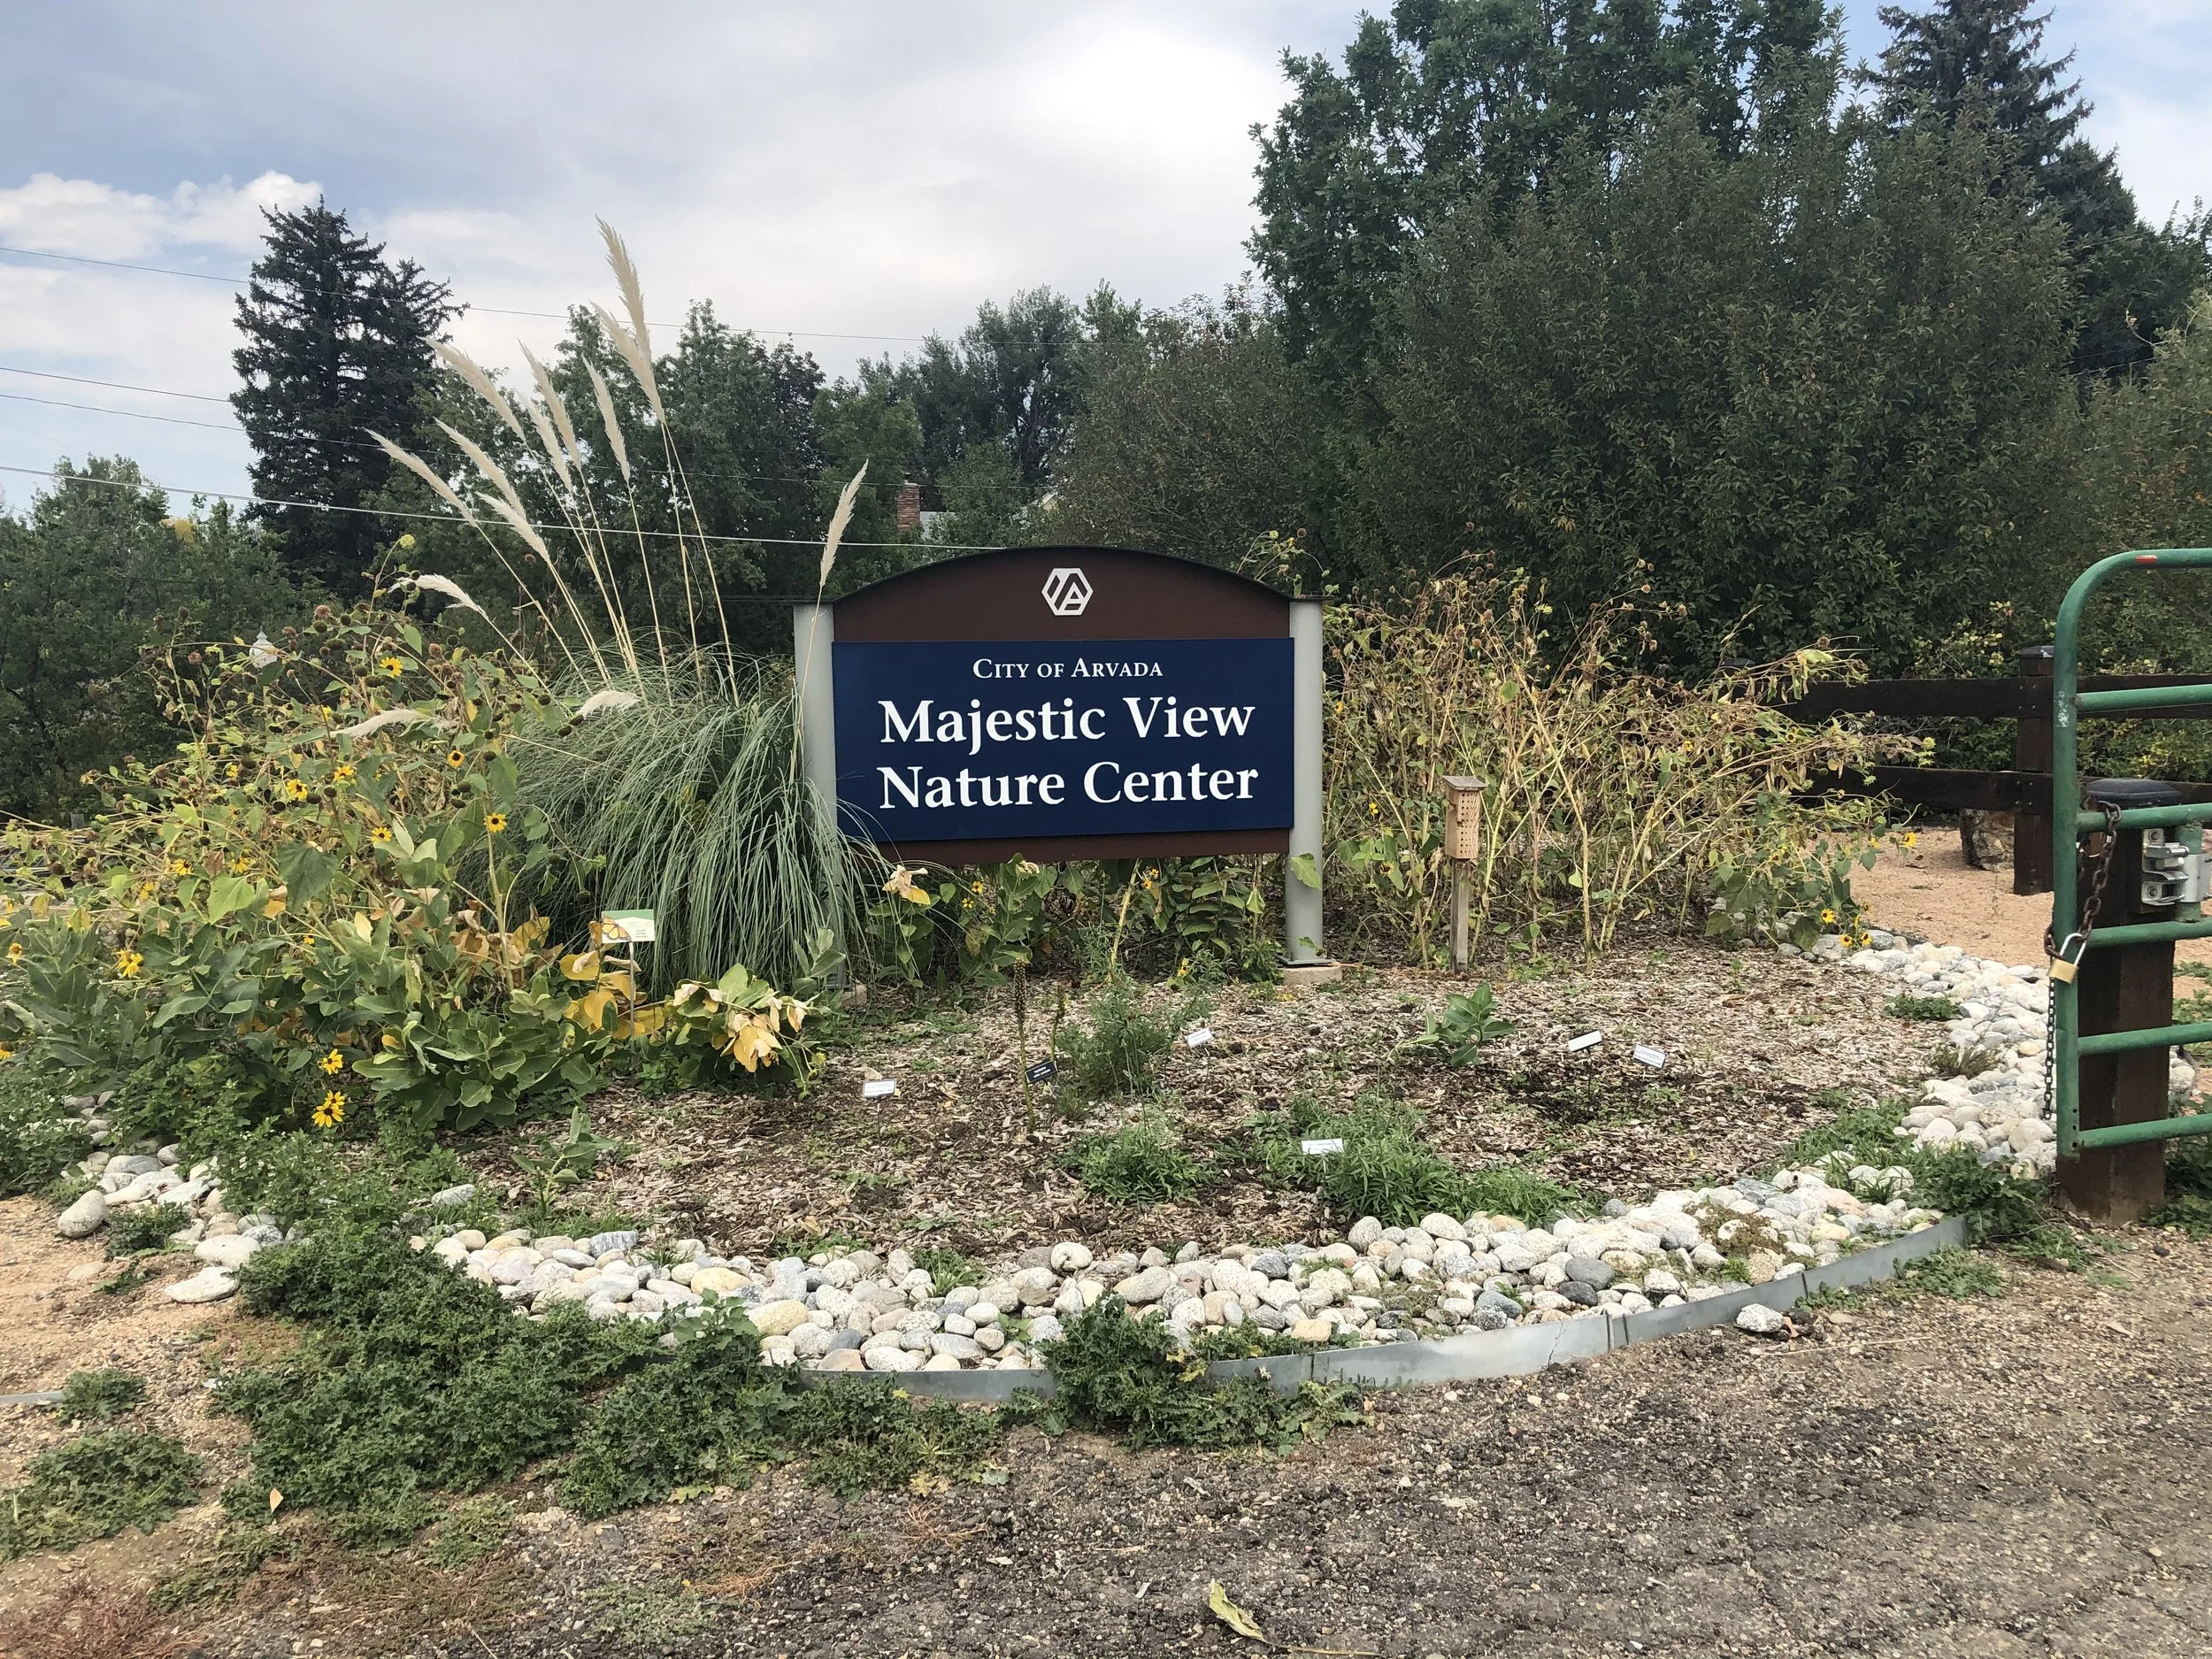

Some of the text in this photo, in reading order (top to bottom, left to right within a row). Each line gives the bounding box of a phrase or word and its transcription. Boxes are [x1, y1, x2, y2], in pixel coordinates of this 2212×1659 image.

[877, 695, 1256, 756] Majestic View
[876, 761, 1259, 809] Nature Center
